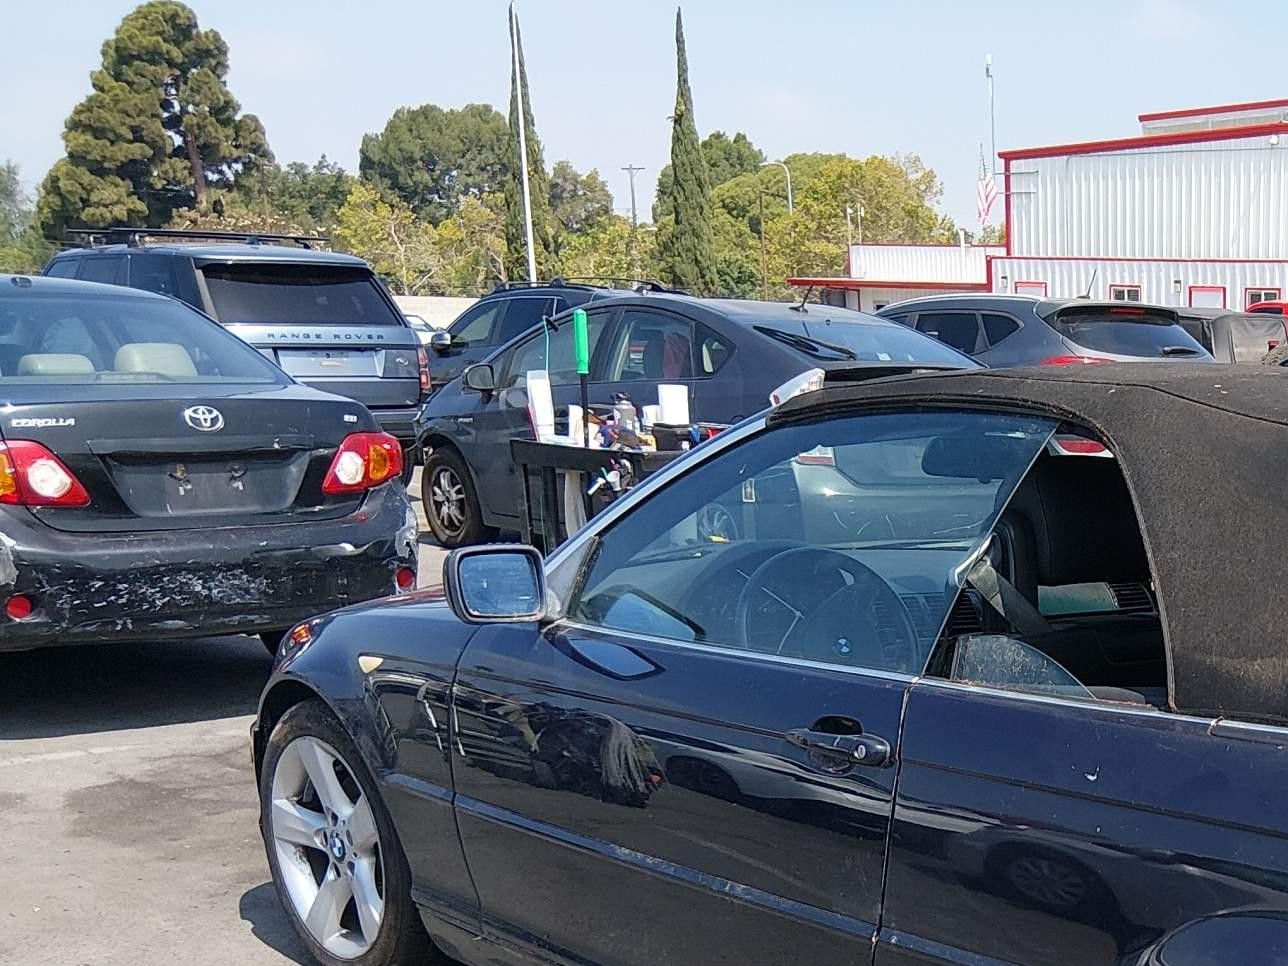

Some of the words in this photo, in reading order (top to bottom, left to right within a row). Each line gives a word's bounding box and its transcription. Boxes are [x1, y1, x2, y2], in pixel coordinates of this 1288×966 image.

[267, 332, 322, 340] RANGE
[333, 333, 385, 341] ROVER
[11, 418, 76, 428] COROLLA
